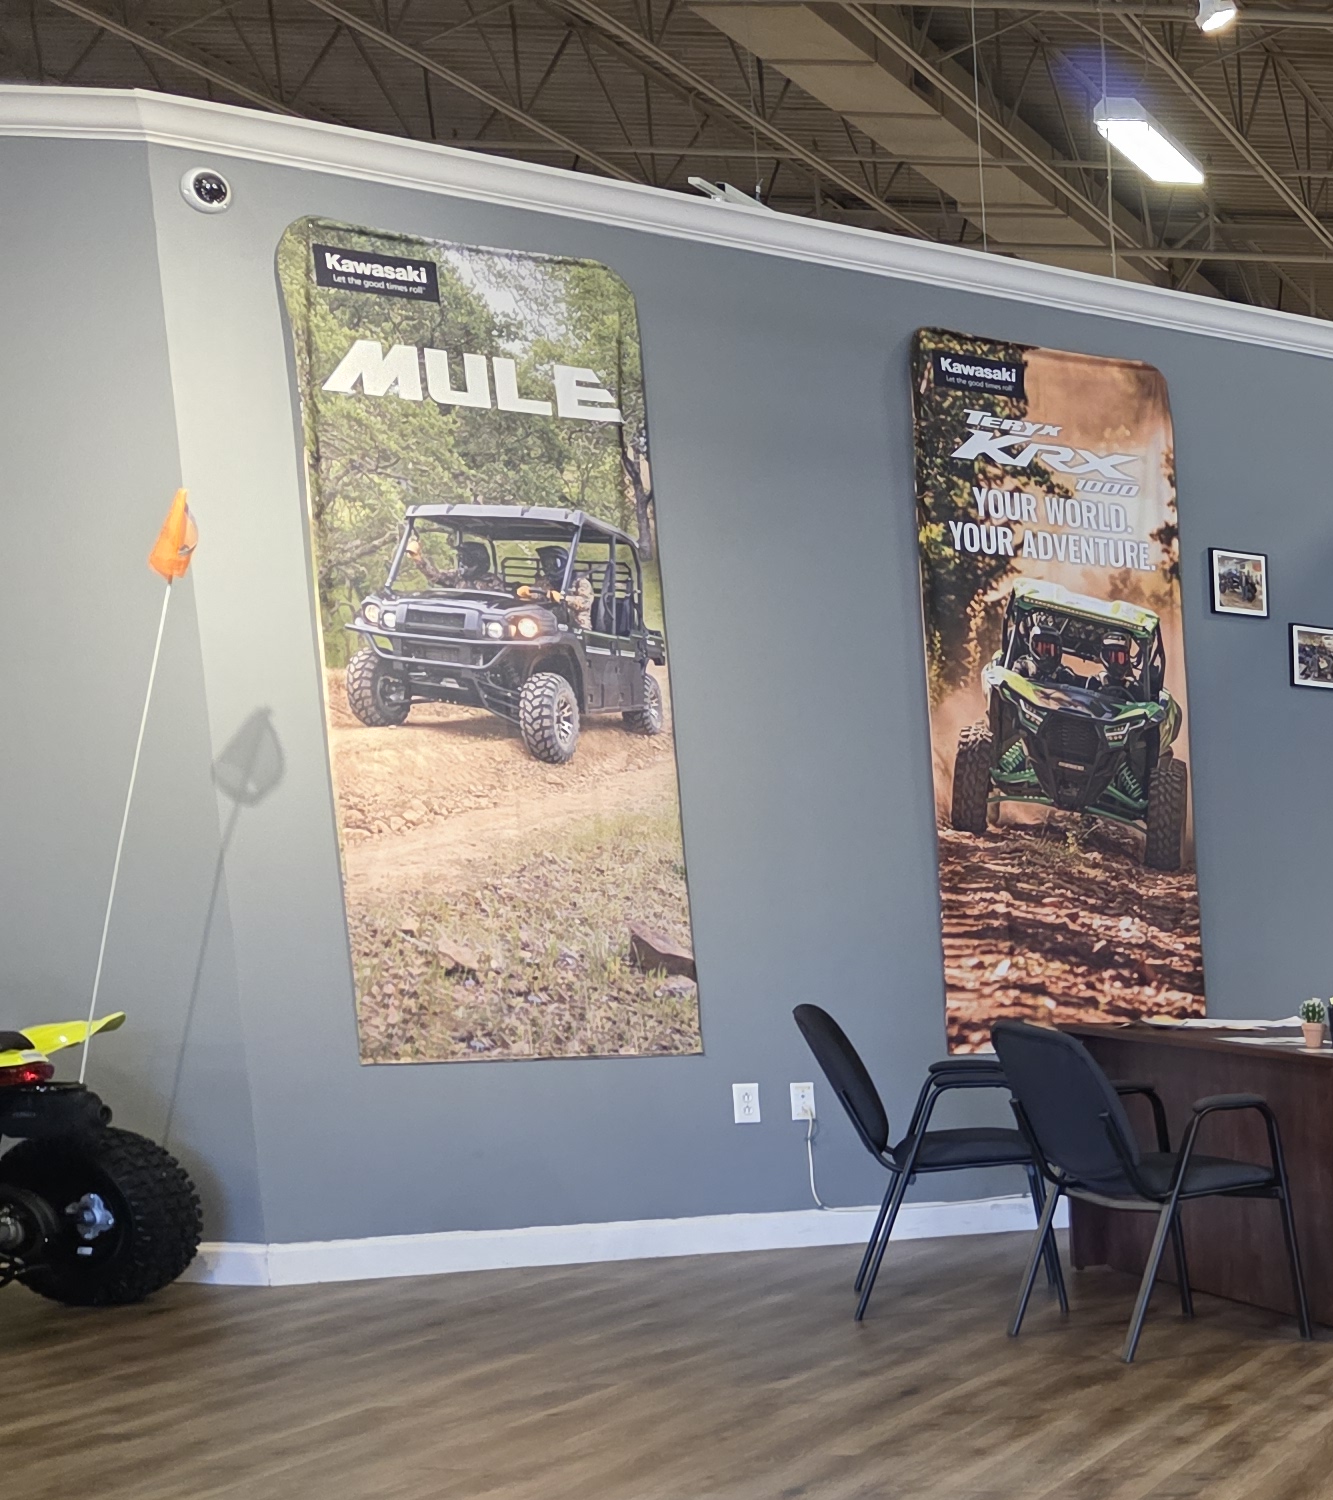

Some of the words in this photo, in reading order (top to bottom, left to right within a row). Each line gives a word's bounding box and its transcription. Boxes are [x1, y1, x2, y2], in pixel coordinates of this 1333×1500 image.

[324, 252, 428, 284] Kawasaki
[332, 273, 347, 284] Let
[348, 275, 361, 287] the
[363, 278, 384, 291] good
[386, 281, 408, 293] times
[322, 339, 626, 424] MULE
[940, 356, 1017, 383] Kawasaki
[945, 374, 956, 383] Let
[956, 376, 967, 385] the
[967, 379, 984, 389] good
[985, 381, 1002, 391] times
[962, 408, 1062, 437] TERYX
[950, 430, 1142, 482] KRX
[1075, 478, 1141, 498] 1000
[972, 486, 1038, 523] YOUR
[1045, 496, 1133, 534] WORLD.
[948, 520, 1015, 556] YOUR
[1022, 533, 1157, 571] ADVENTURE.
